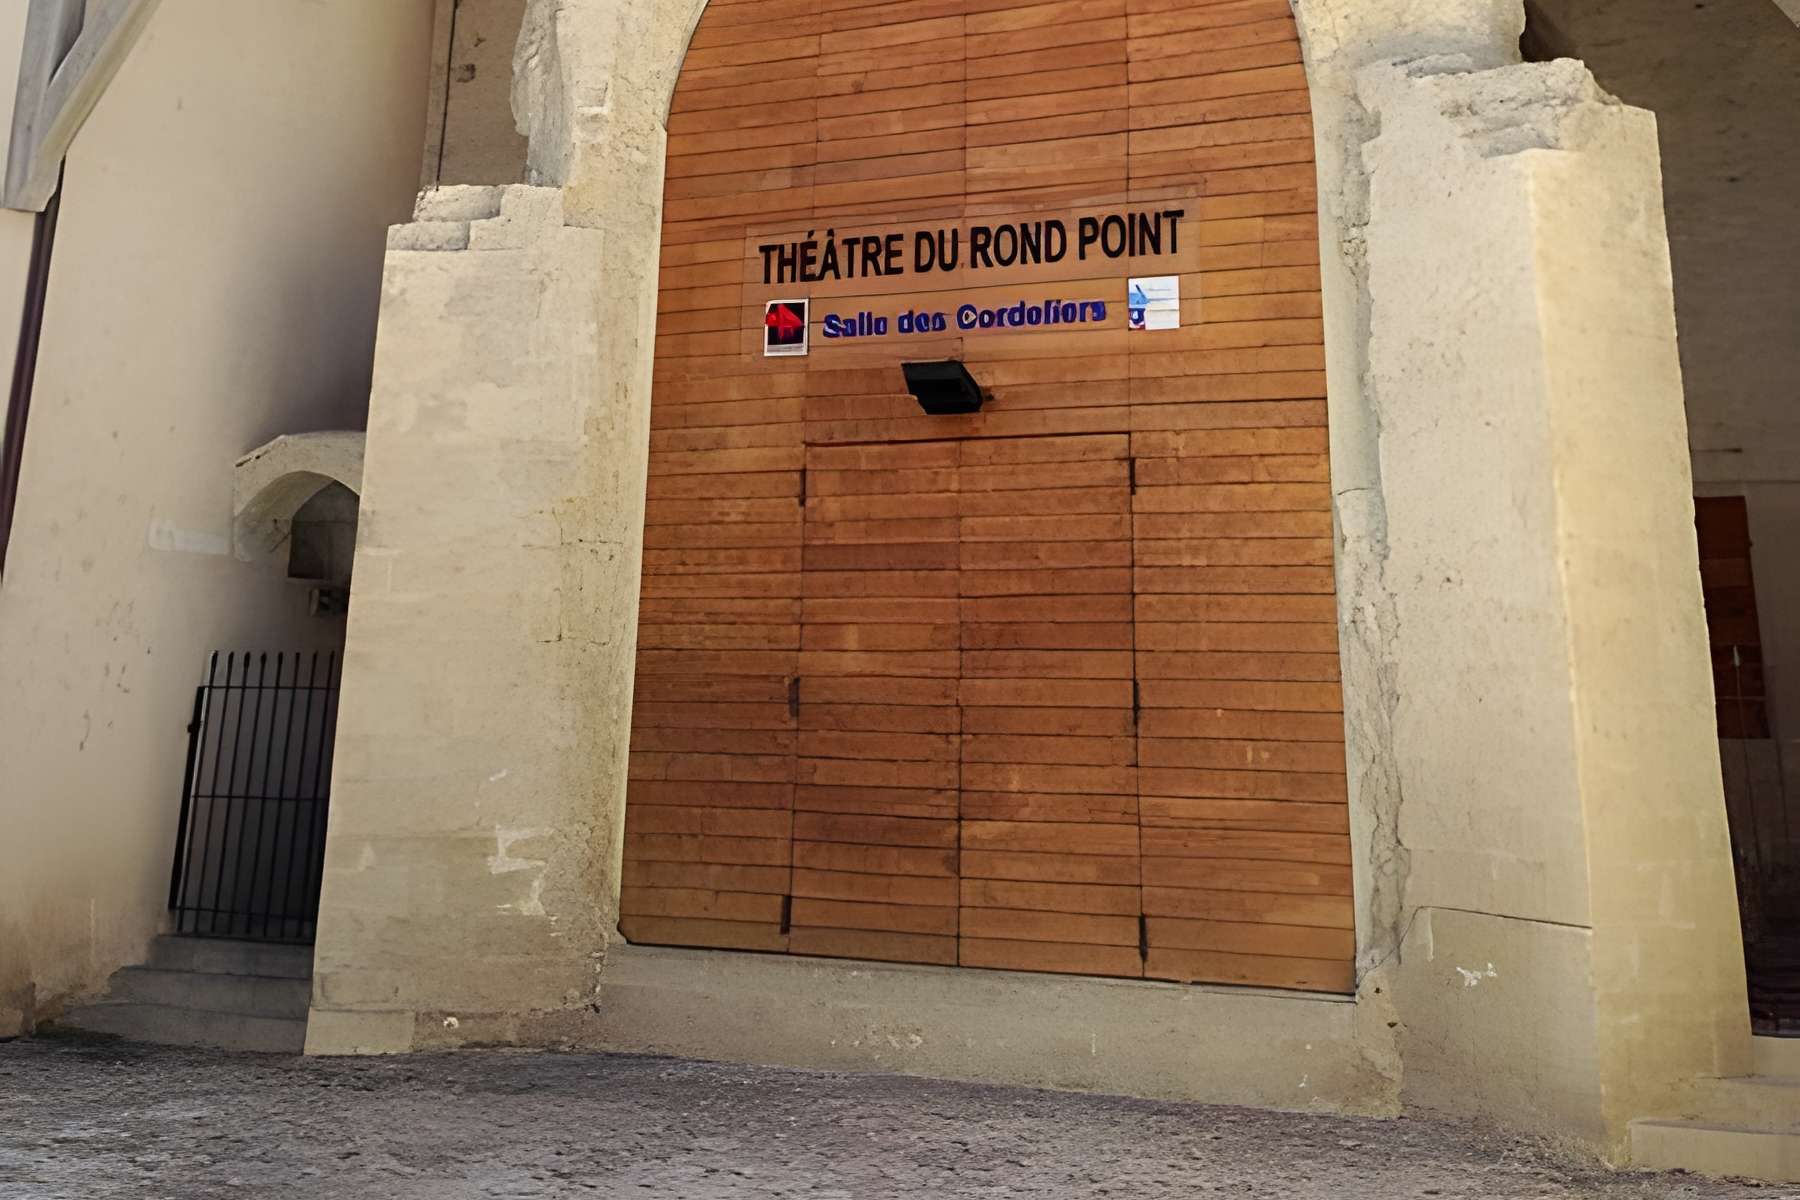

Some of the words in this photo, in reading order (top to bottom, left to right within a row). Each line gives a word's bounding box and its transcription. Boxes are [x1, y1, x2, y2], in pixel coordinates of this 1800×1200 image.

[759, 228, 904, 285] THÉÂTRE
[914, 228, 959, 273] DU
[970, 219, 1068, 269] ROND
[1079, 209, 1185, 261] POINT
